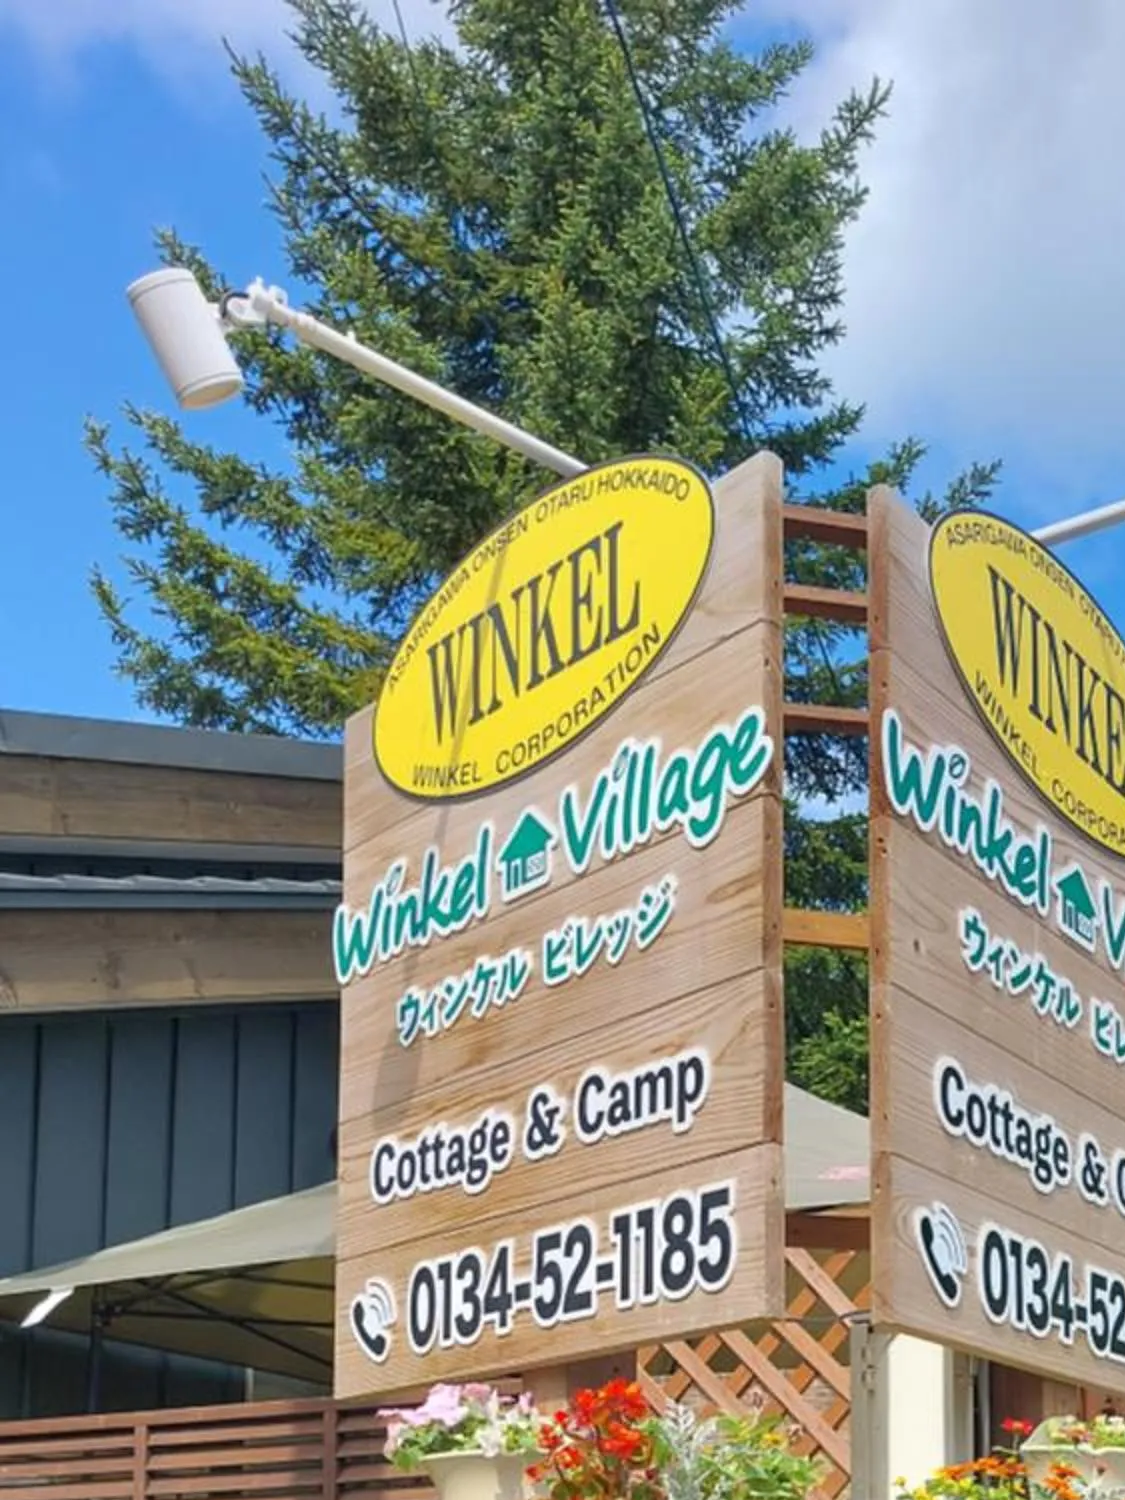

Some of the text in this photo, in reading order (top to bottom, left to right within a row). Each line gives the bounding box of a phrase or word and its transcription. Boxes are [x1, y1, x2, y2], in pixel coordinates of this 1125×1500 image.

[387, 467, 692, 695] ASARIGAWA ONSEN OTARU HOKKAIDO
[426, 520, 642, 748] WINKEL
[411, 622, 664, 788] WINKEL CORPORATION
[974, 670, 1043, 780] WINKEL
[336, 713, 767, 978] Winkel Village
[887, 714, 1051, 908] Winkel
[398, 879, 676, 1042] ウィンケル ビレッジ
[374, 1053, 704, 1198] Cottage & Camp
[940, 1065, 1069, 1185] Cottage
[1081, 1140, 1106, 1199] &
[409, 1187, 733, 1348] 0134-52-1185
